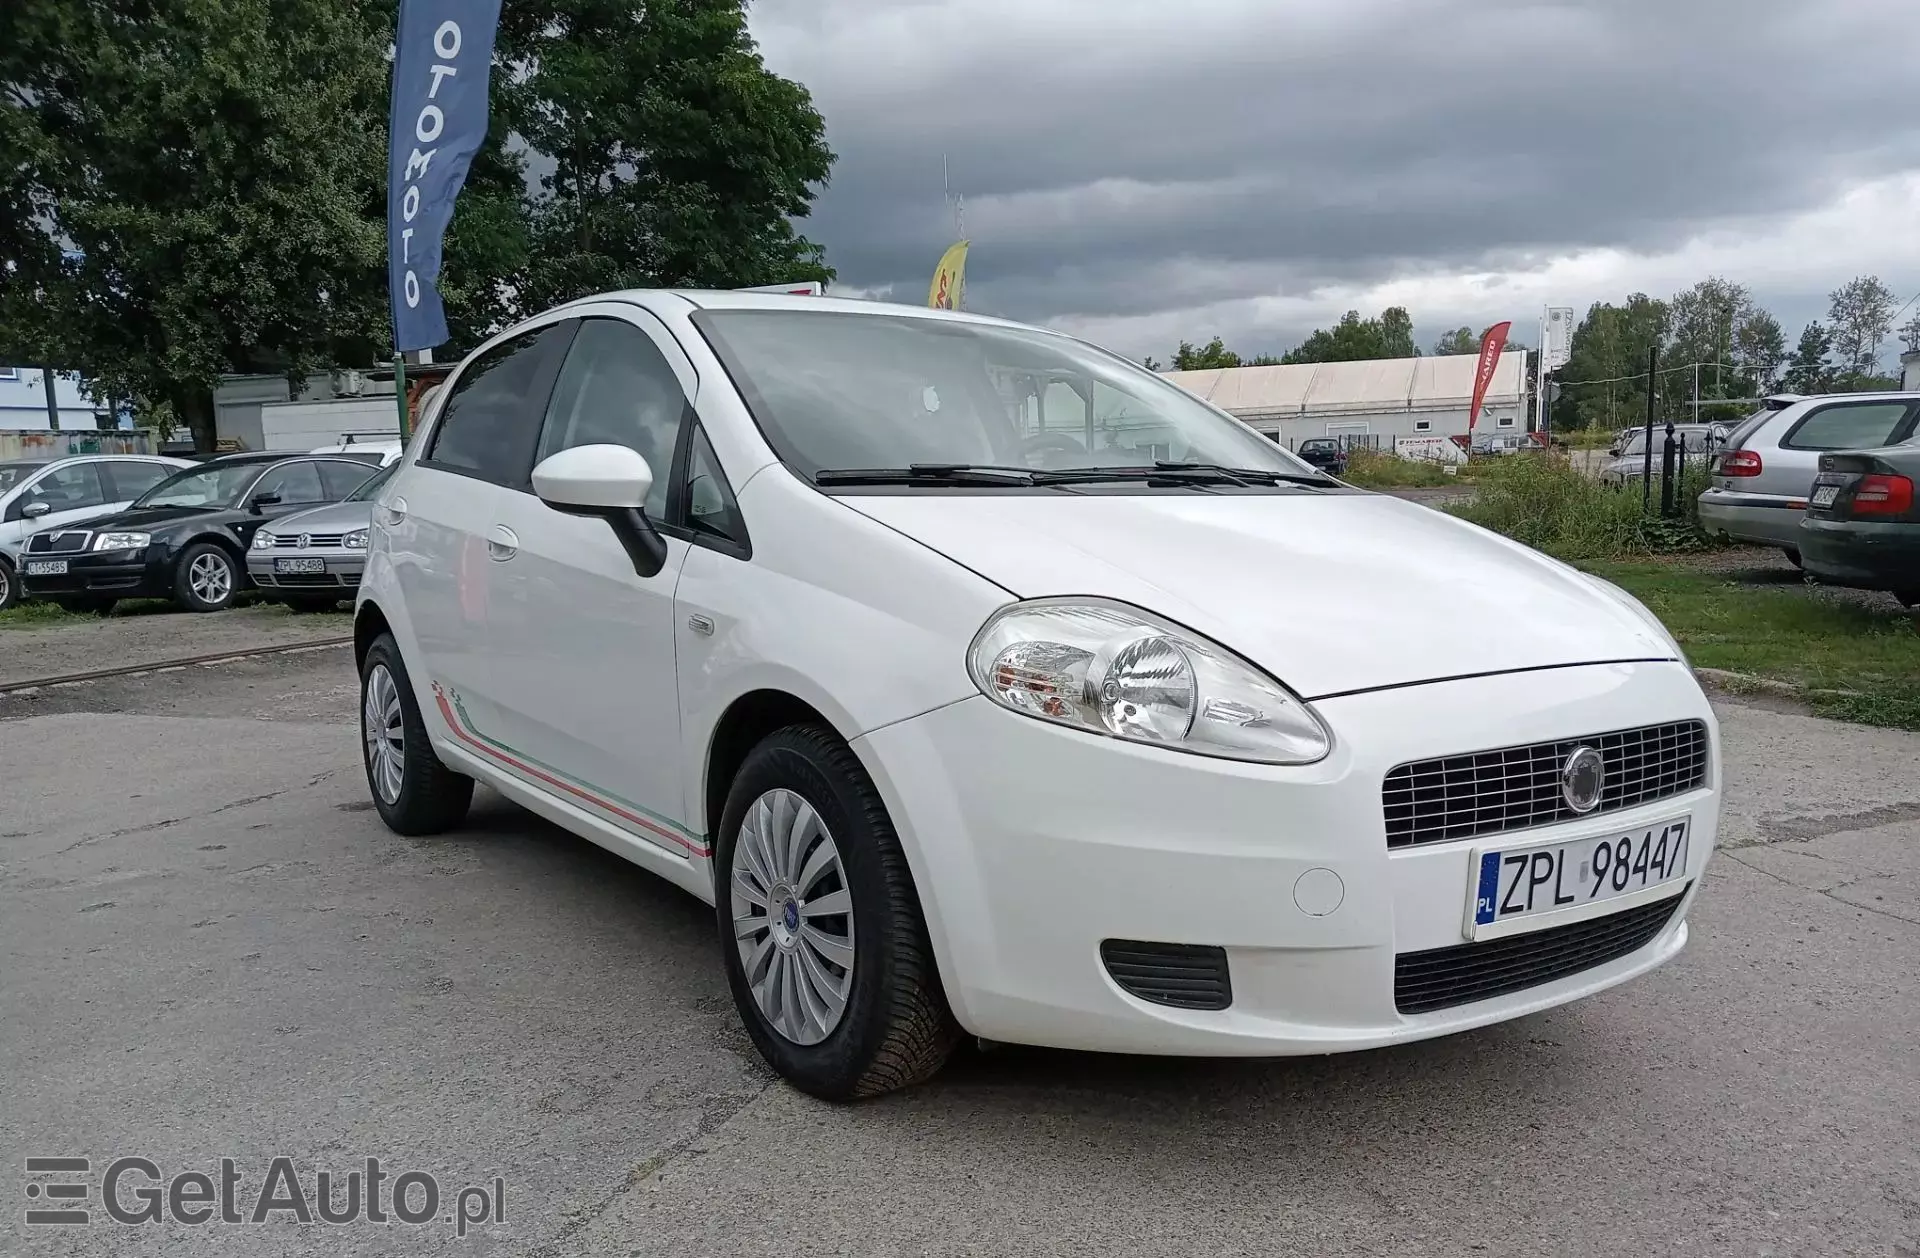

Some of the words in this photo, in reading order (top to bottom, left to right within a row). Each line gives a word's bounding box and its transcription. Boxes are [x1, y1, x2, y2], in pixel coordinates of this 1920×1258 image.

[402, 20, 462, 309] OTOMOTO
[1477, 897, 1492, 914] PL
[1499, 848, 1575, 915] ZPL
[1589, 823, 1686, 899] 98447
